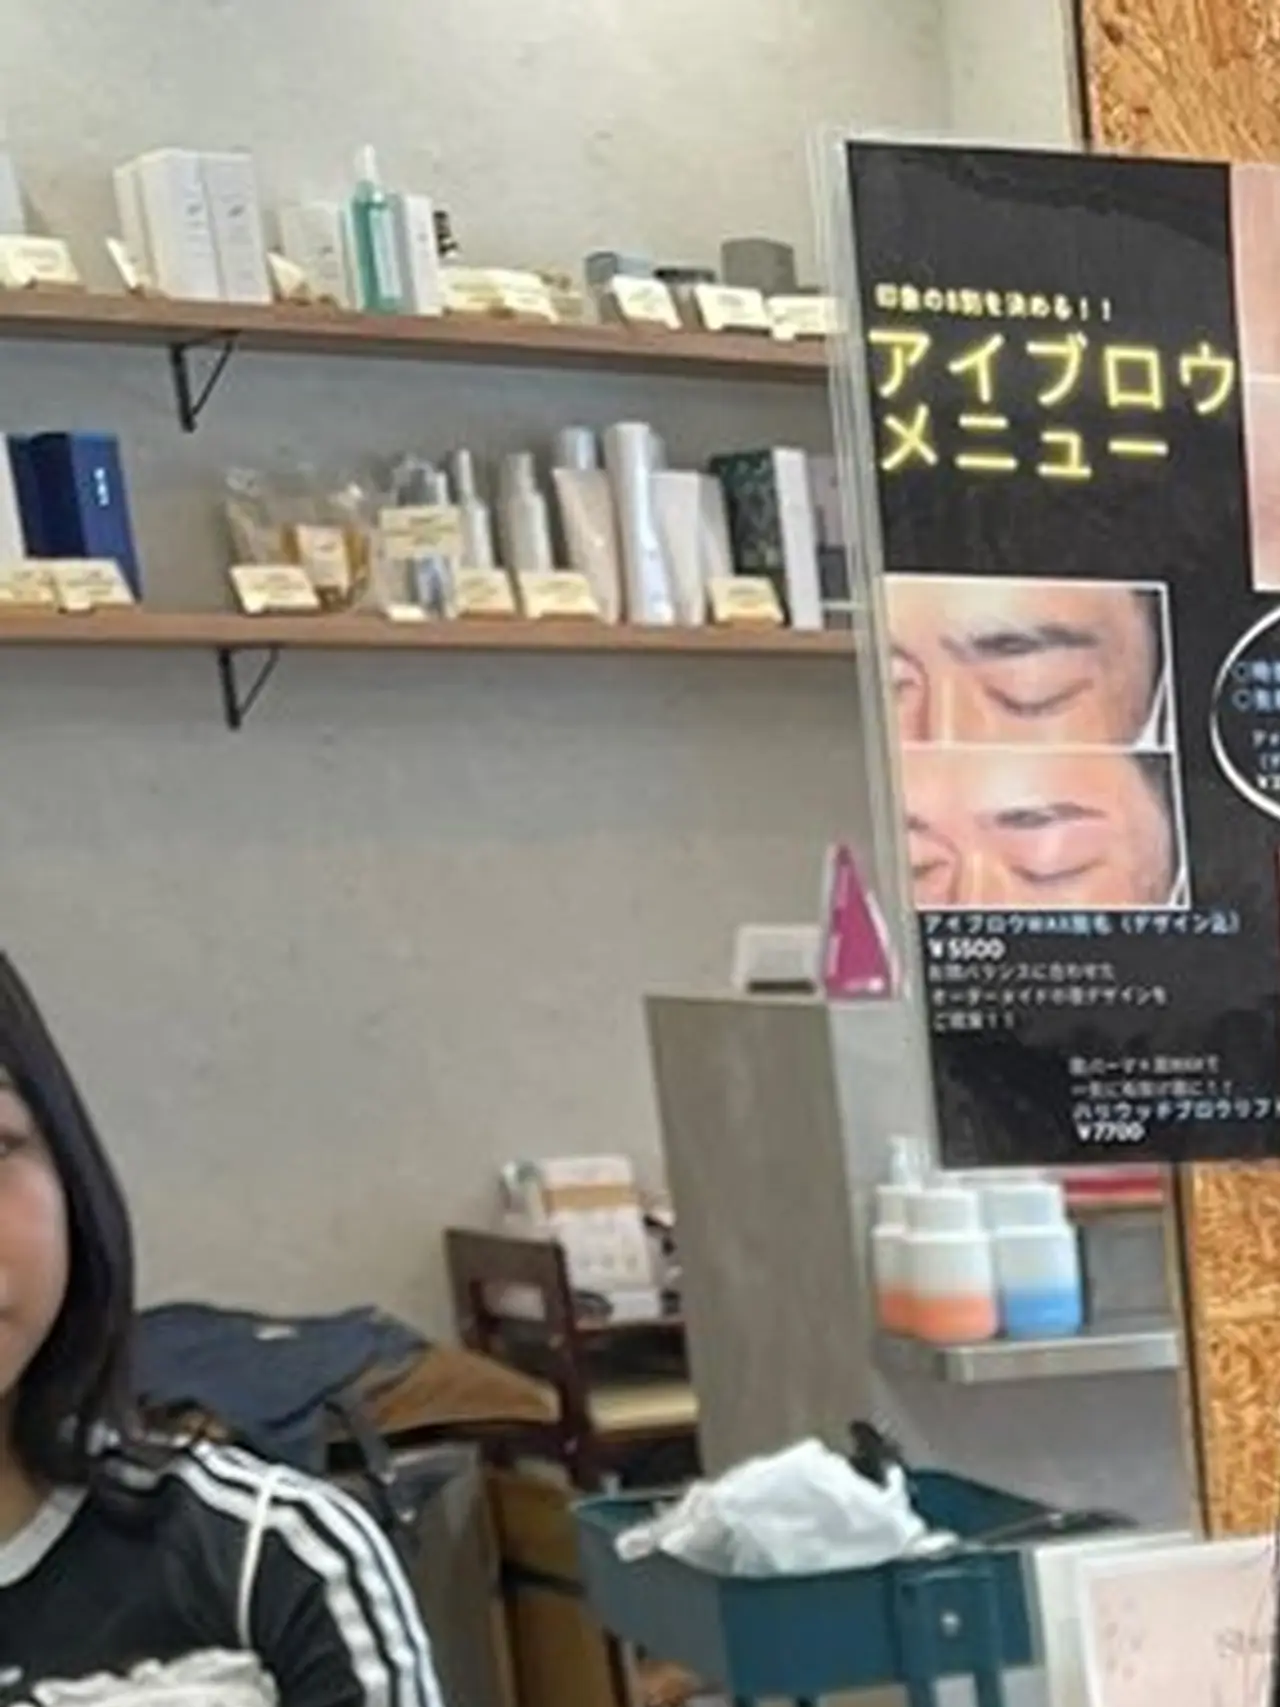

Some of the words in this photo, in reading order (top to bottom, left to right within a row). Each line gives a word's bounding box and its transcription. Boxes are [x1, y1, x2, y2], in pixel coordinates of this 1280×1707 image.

[868, 330, 1235, 414] アイブロウ
[880, 403, 1169, 480] メニュー
